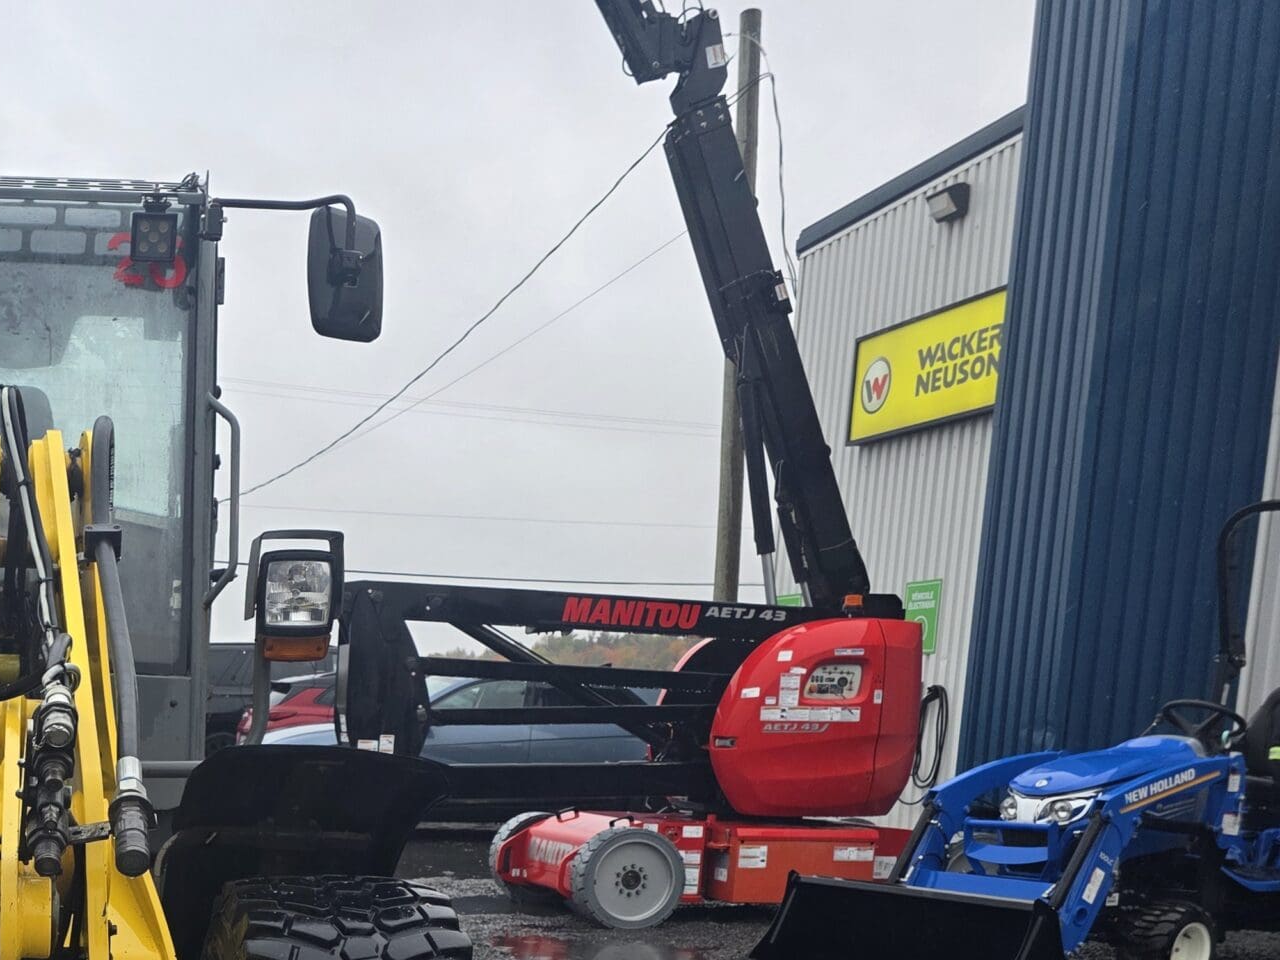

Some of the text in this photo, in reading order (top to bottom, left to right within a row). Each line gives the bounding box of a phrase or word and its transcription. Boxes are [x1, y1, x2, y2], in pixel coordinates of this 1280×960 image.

[918, 323, 1002, 371] WACKER
[915, 352, 1000, 397] NEUSON
[562, 597, 787, 629] MANITOU AETJ 43
[763, 722, 798, 731] AETJ
[1124, 785, 1149, 805] NEW
[1149, 767, 1195, 796] HOLLAND
